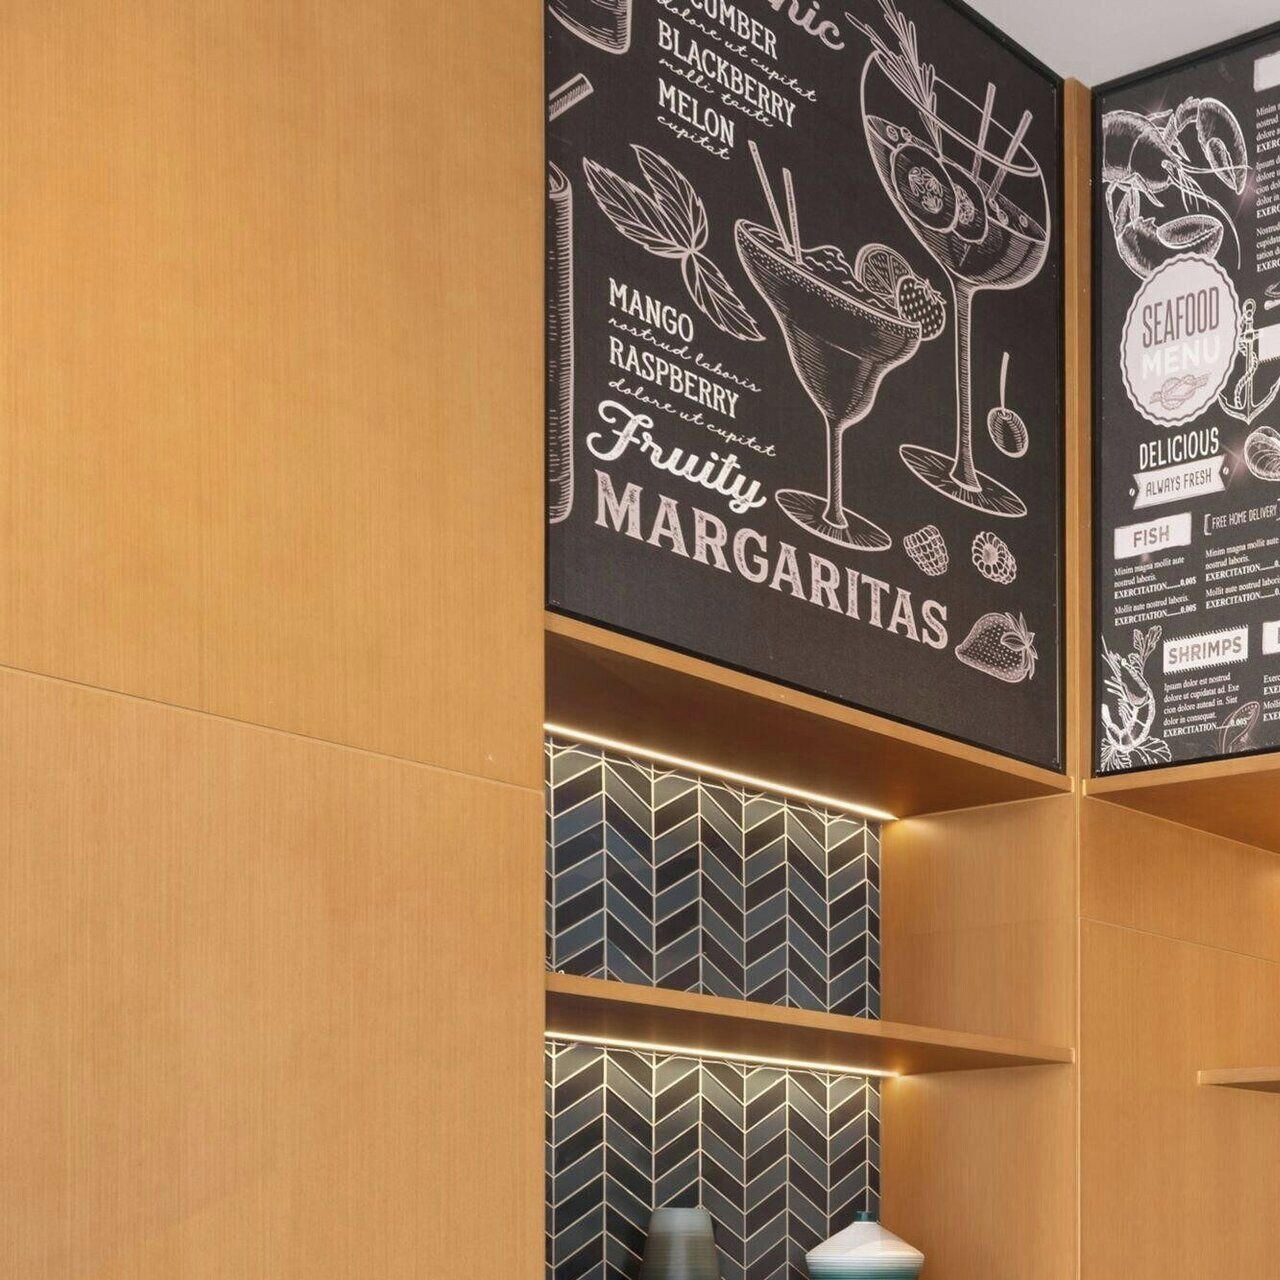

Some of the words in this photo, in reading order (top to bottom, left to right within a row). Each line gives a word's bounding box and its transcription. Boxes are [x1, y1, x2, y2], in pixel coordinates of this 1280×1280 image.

[690, 0, 778, 60] UMBER
[768, 0, 845, 50] nic
[658, 18, 796, 128] BLACKBERRY
[725, 41, 748, 58] ut
[659, 58, 714, 94] molli
[658, 77, 735, 148] MELON
[609, 277, 694, 343] MANGO
[1142, 286, 1220, 348] SEAFOOD
[609, 335, 739, 419] RASPBERRY
[695, 353, 762, 392] laboris
[1142, 335, 1220, 380] MENU
[608, 378, 676, 413] dolore
[680, 411, 704, 426] ut
[586, 399, 767, 514] Fruity
[1139, 427, 1219, 470] DELICIOUS
[1146, 475, 1181, 497] ALWAYS
[1183, 468, 1212, 489] FRESH
[1133, 525, 1170, 548] FISH
[1212, 514, 1227, 530] FREE
[1229, 510, 1247, 525] HOME
[1249, 504, 1278, 521] DELIVERY
[594, 468, 949, 650] MARGARITAS
[1168, 636, 1242, 665] SHRIMPS
